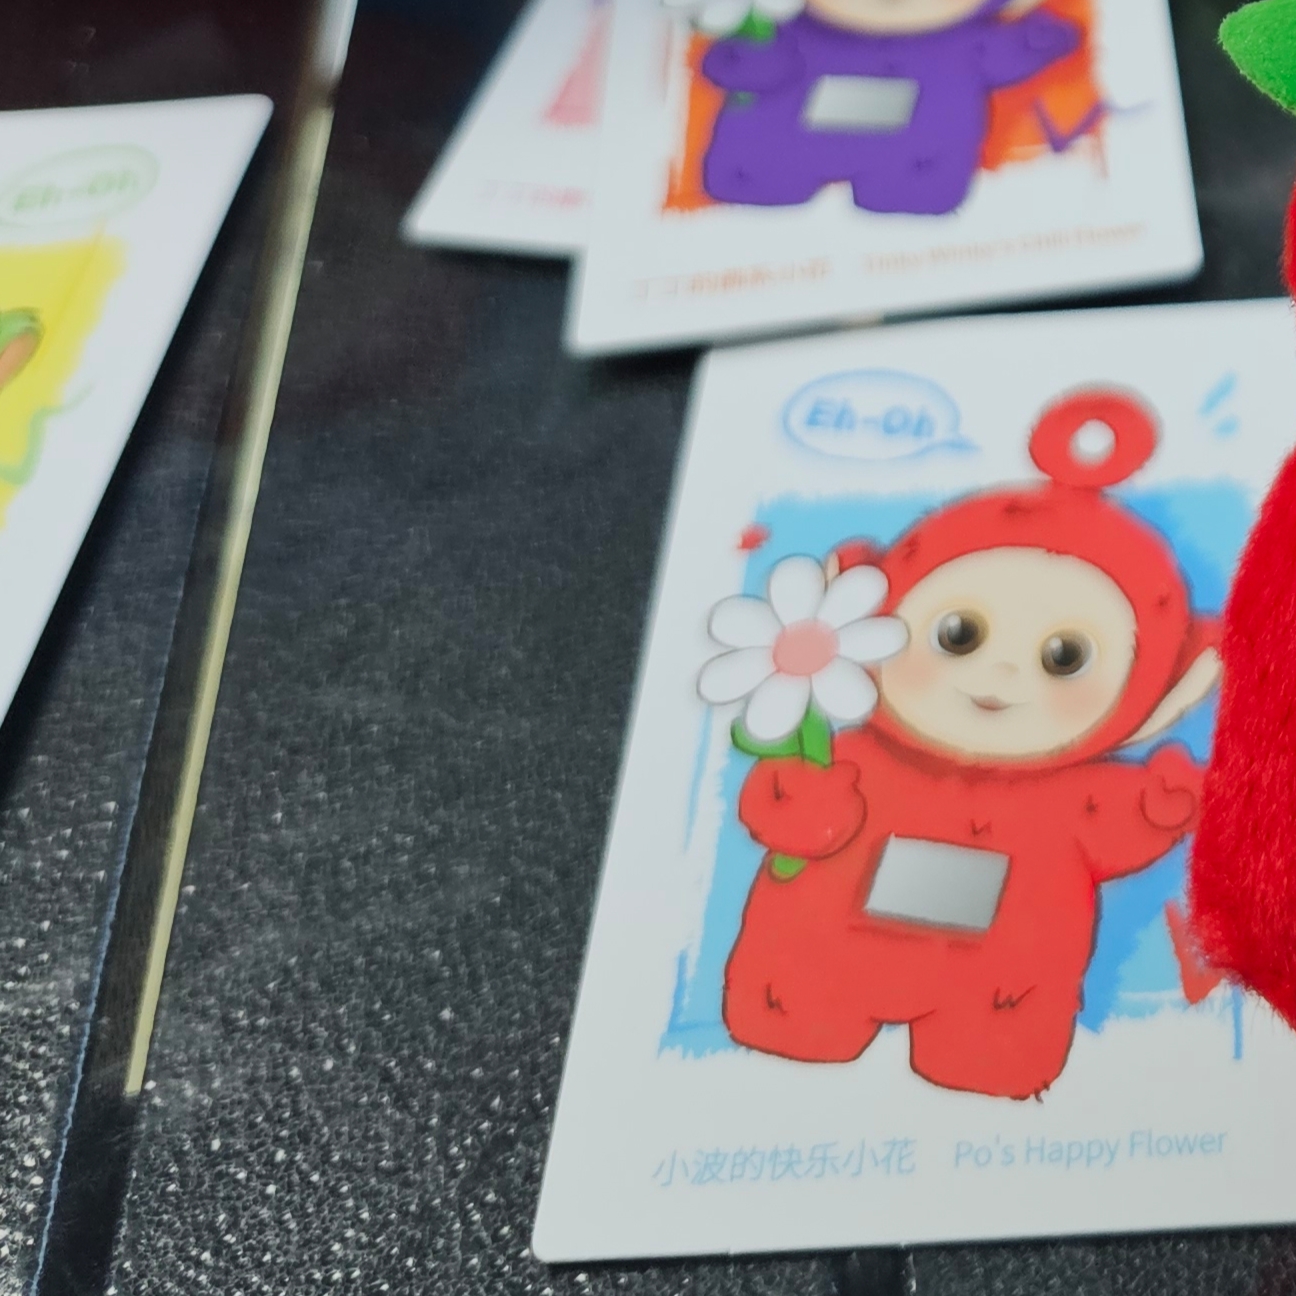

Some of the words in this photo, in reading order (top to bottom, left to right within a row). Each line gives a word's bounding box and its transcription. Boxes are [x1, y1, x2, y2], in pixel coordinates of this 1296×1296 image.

[806, 397, 935, 438] Eh-Oh
[652, 1138, 917, 1187] 小波的快乐小花
[954, 1133, 1016, 1169] Po's
[1024, 1135, 1121, 1170] Happy
[1127, 1129, 1228, 1158] Flower
